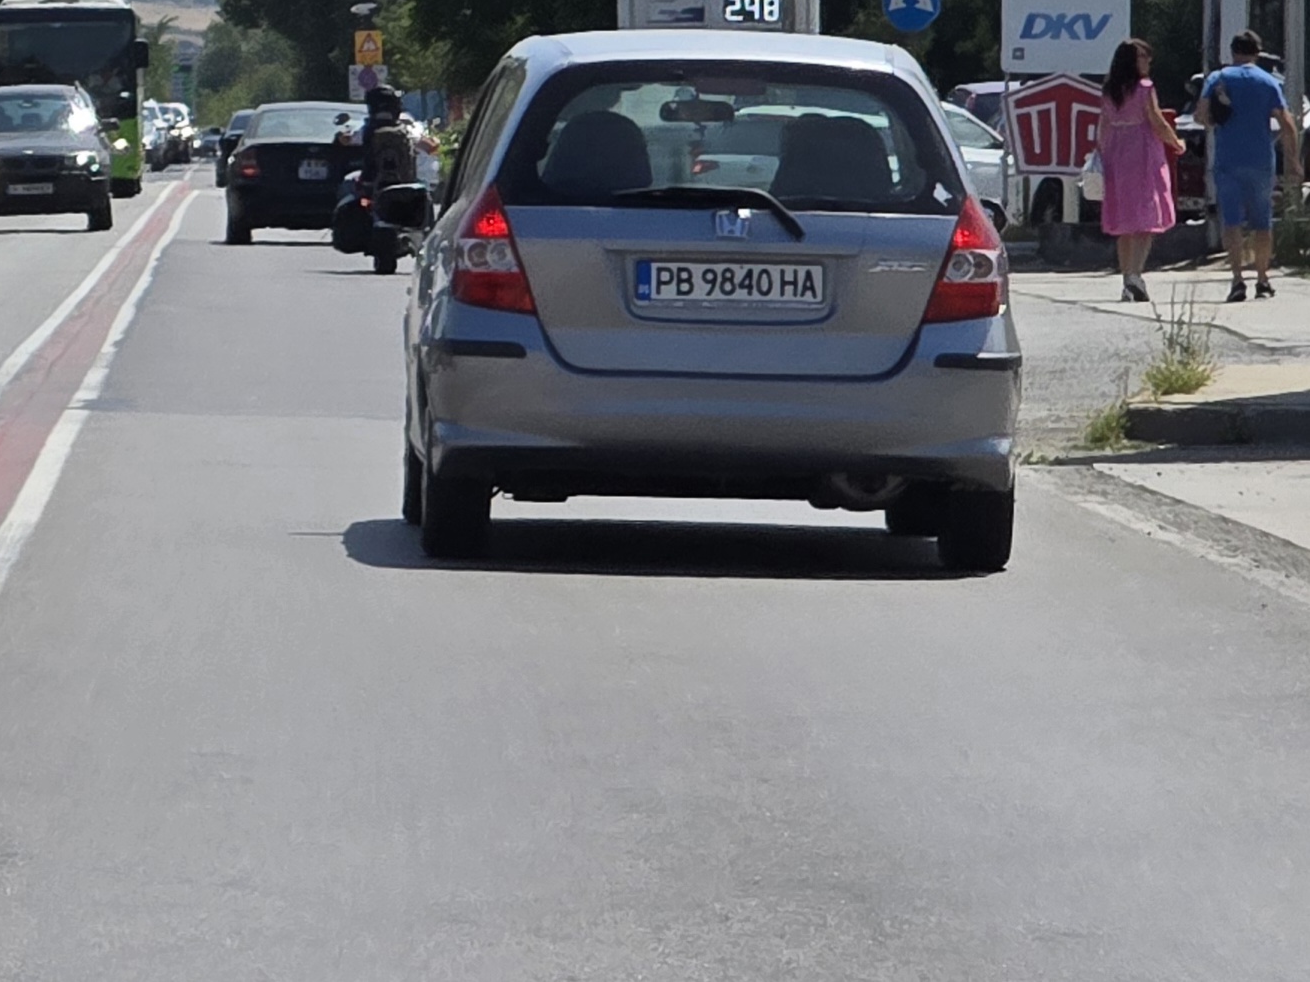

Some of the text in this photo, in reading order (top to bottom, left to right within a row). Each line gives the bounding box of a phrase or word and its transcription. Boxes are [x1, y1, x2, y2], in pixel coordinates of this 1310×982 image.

[1020, 13, 1113, 40] DKV
[655, 267, 694, 296] PB
[701, 268, 773, 297] 9840
[779, 270, 817, 299] HA
